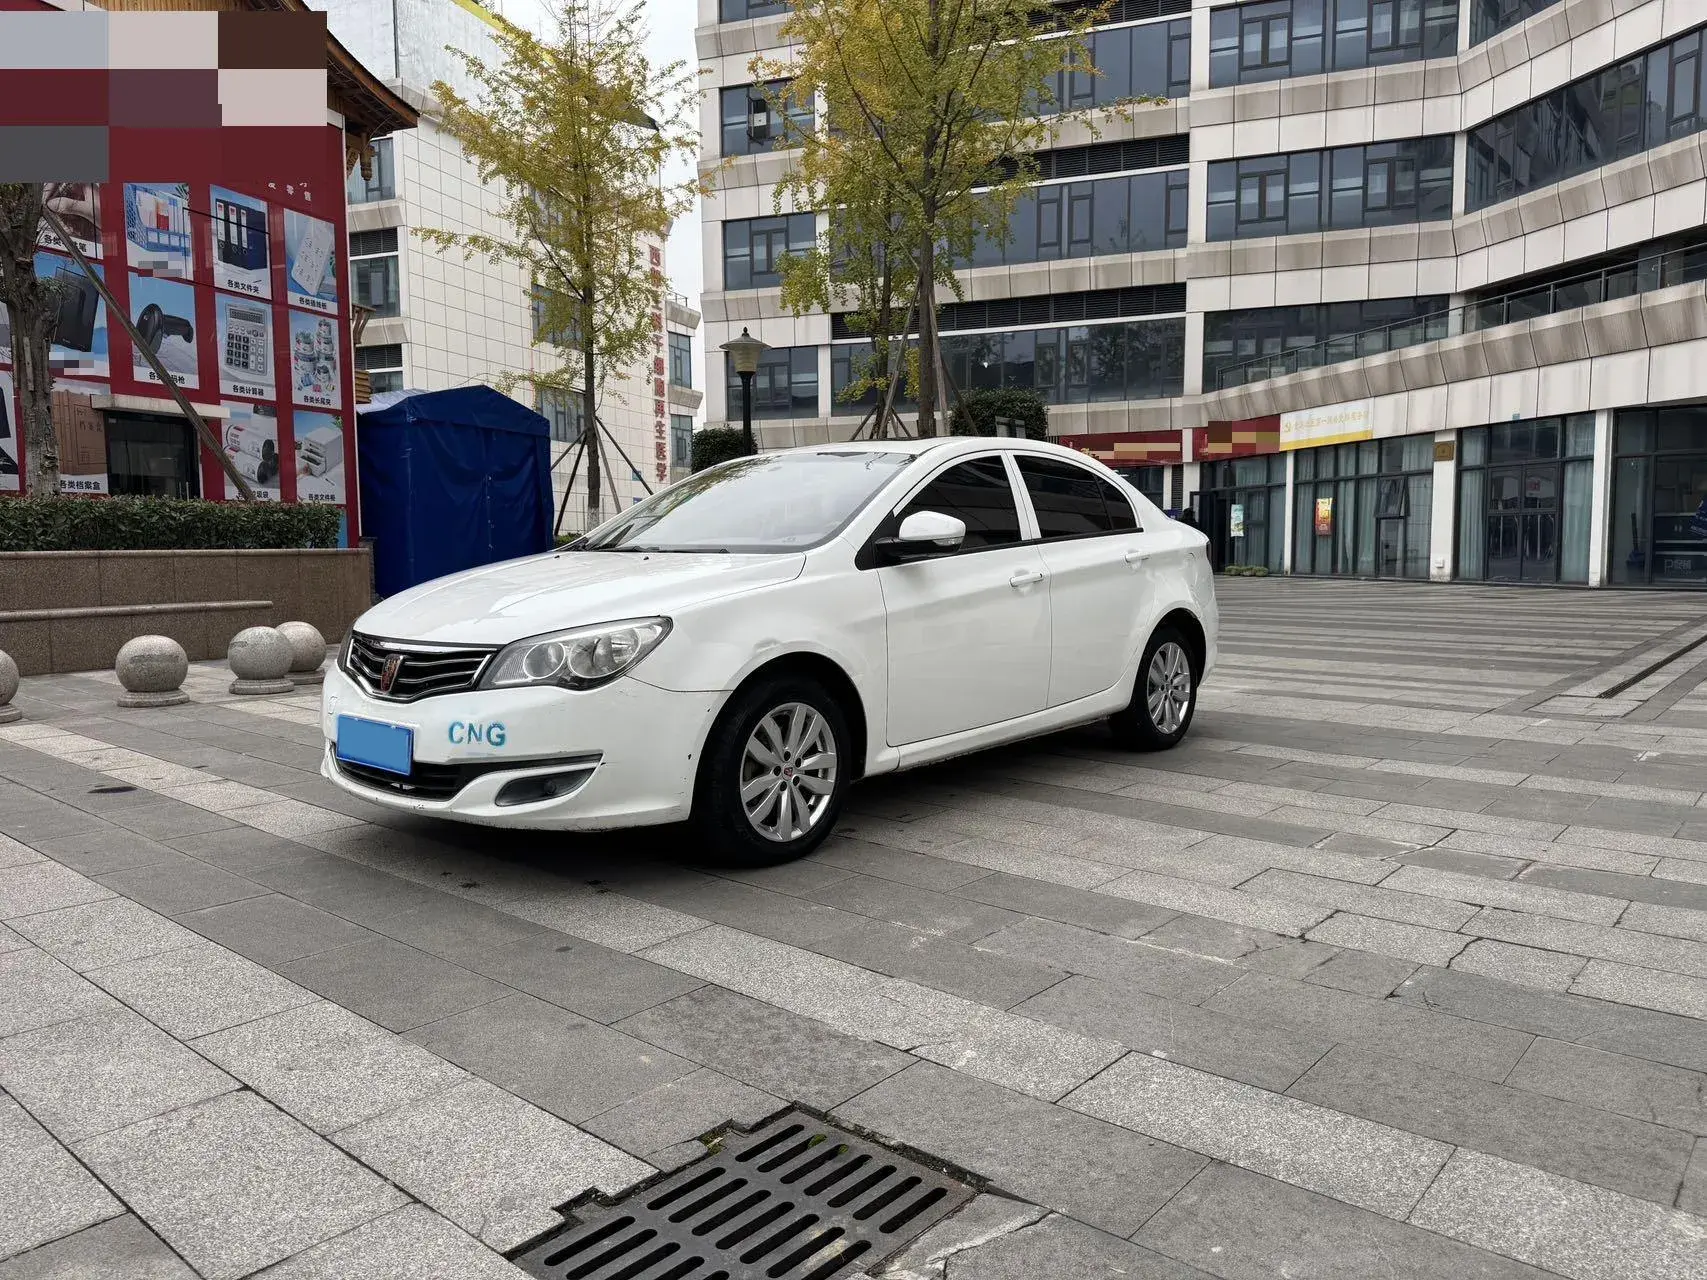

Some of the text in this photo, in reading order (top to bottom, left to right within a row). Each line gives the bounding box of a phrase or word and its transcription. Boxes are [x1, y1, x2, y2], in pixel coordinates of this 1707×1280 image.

[227, 279, 260, 294] 各类文件夹
[232, 384, 264, 397] 各类计算器
[303, 395, 332, 406] 各类长尾夹
[60, 480, 101, 491] 各类档案盒
[448, 721, 506, 747] CNG
